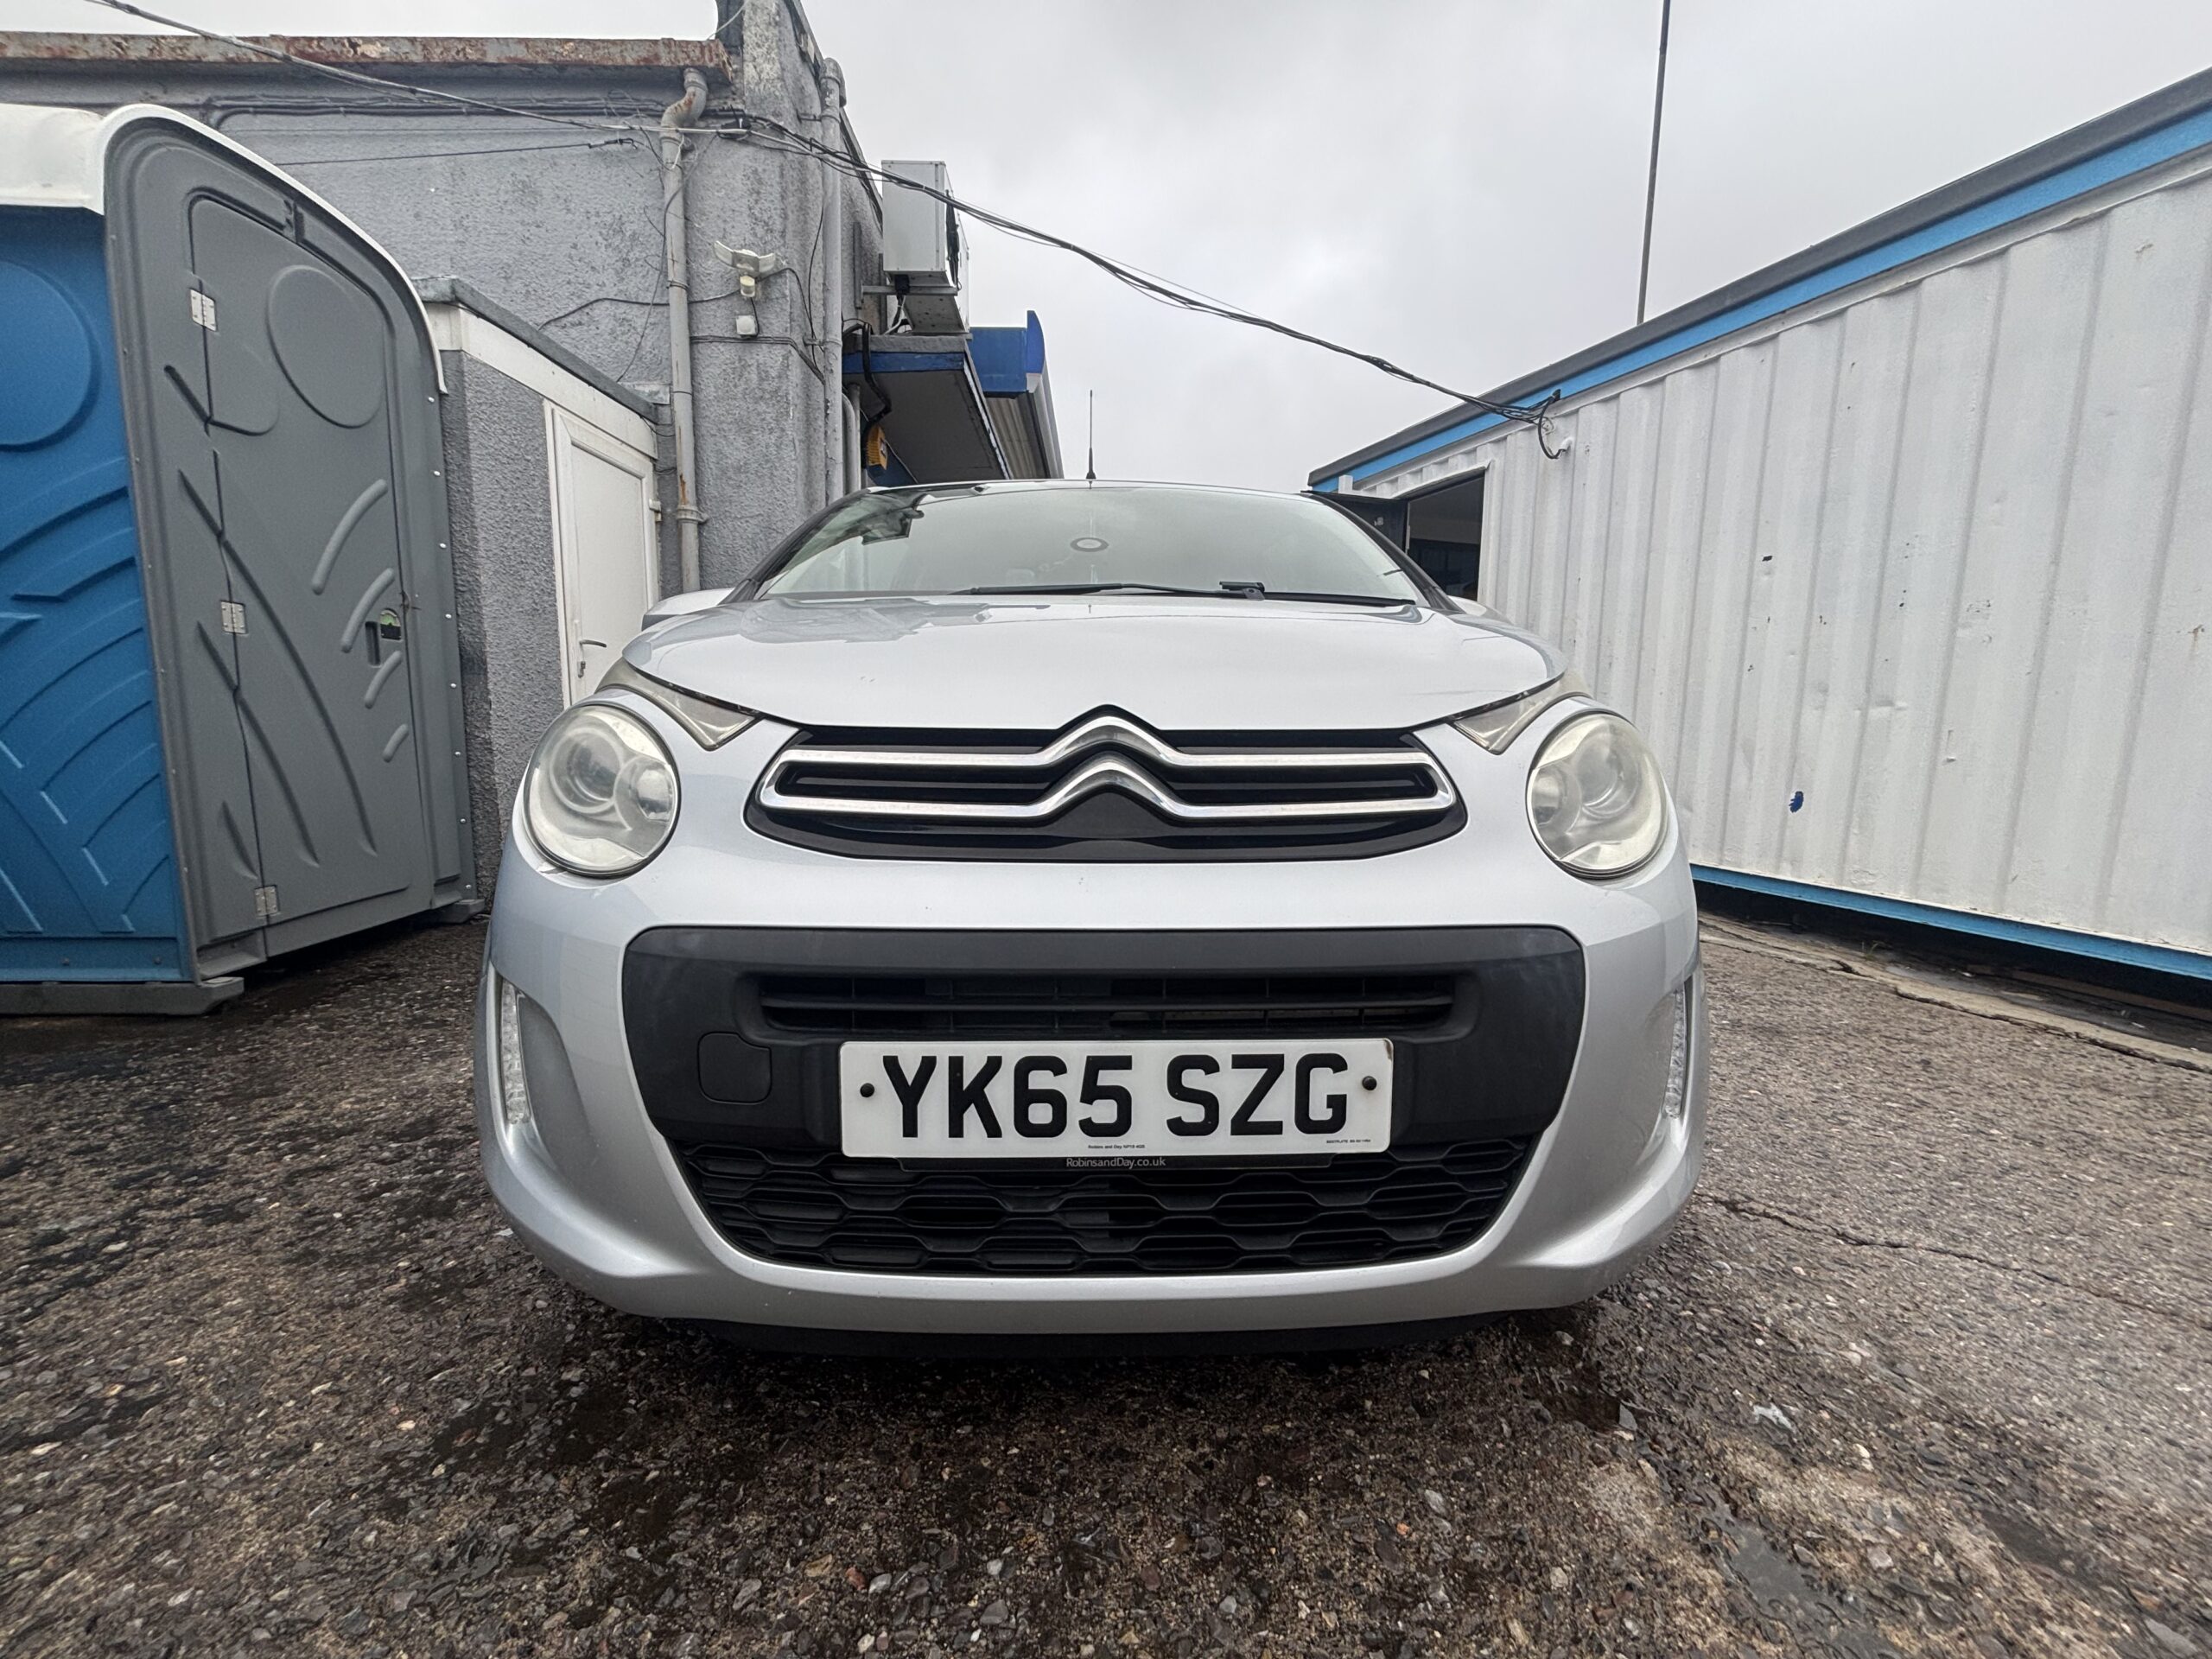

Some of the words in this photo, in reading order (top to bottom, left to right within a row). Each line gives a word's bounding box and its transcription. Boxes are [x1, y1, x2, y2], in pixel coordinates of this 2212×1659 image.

[882, 1055, 1133, 1139] YK65
[1166, 1052, 1348, 1137] SZG
[1065, 1157, 1166, 1170] RobinsandDay.co.uk
